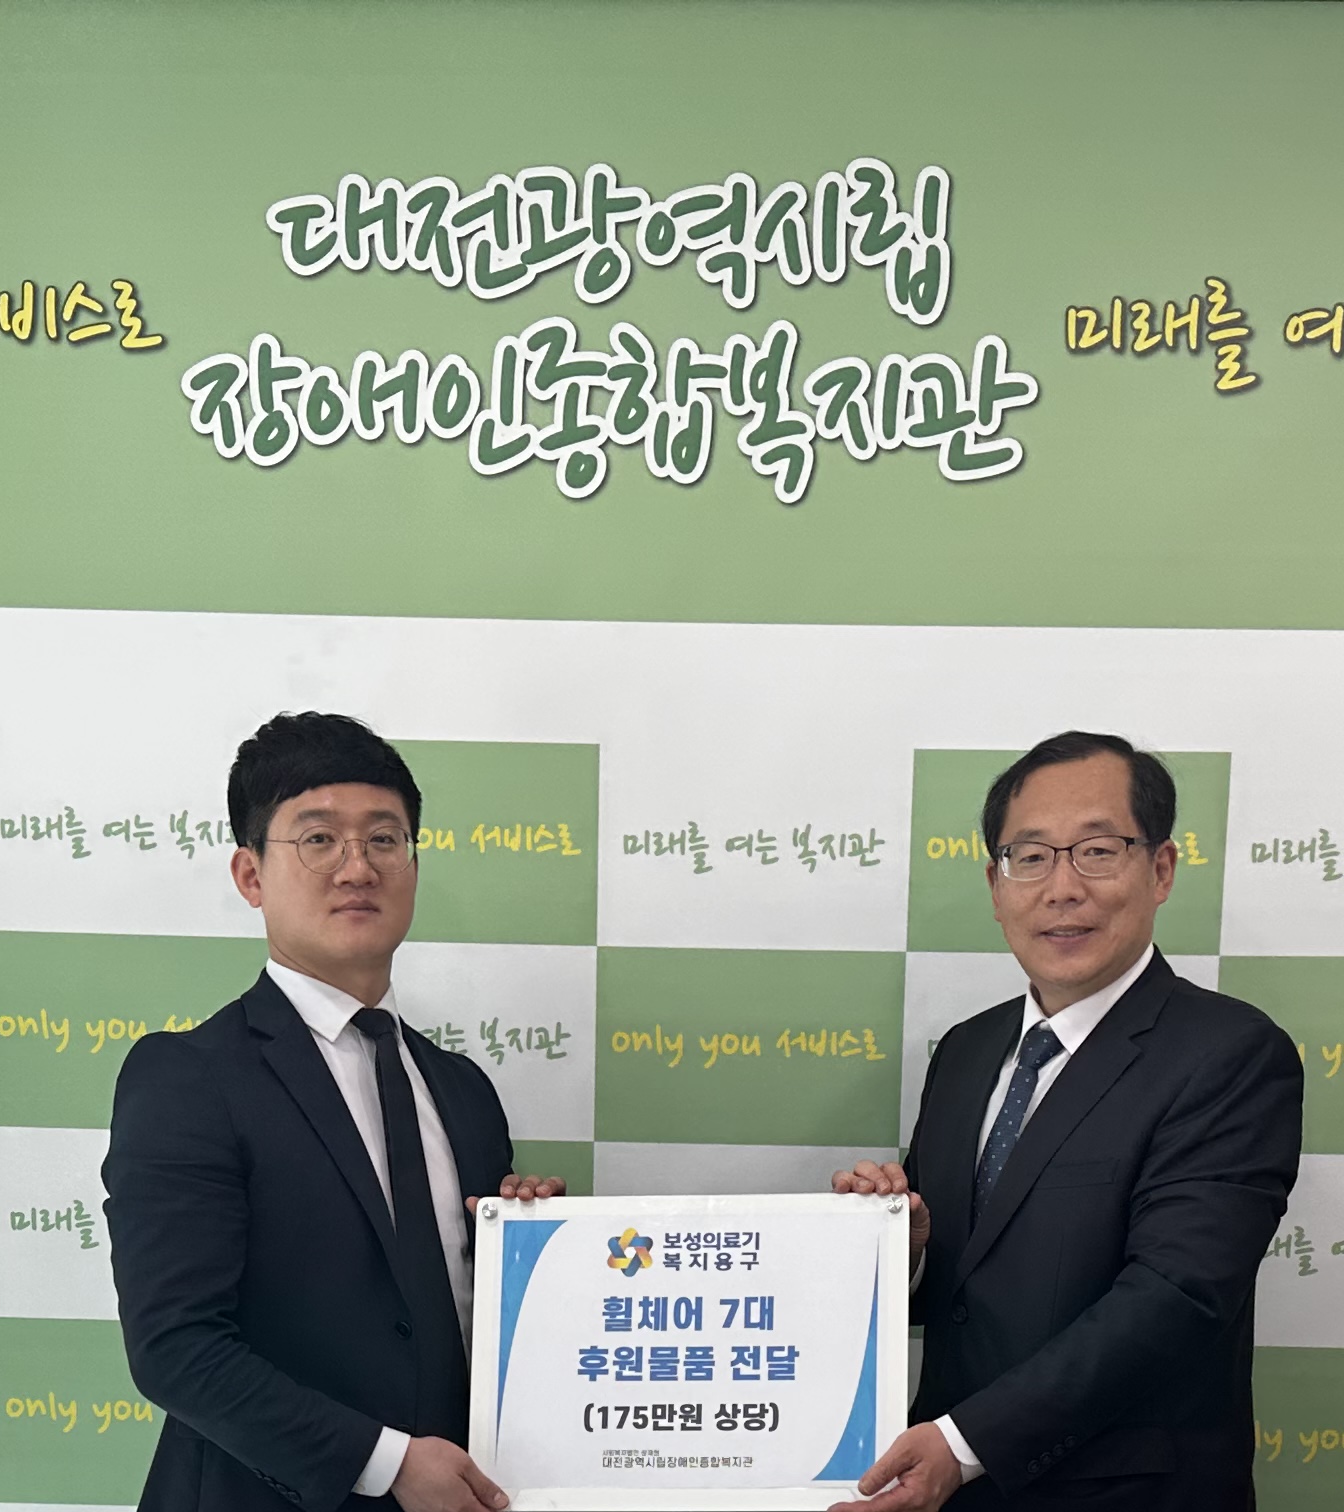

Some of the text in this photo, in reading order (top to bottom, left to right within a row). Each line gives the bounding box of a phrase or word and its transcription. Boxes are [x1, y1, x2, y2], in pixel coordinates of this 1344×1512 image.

[267, 157, 952, 326] 대전광역시립
[1068, 280, 1253, 389] 미래를
[180, 317, 1039, 505] 장애인종합복지관
[0, 806, 236, 859] 미래를 여는 복지
[417, 824, 580, 855] ou 서비스로
[623, 821, 885, 874] 미래를 여는 복지관
[926, 830, 989, 861] onl
[1251, 828, 1343, 882] 미래를
[85, 1018, 146, 1053] you
[479, 1016, 572, 1065] 복지관
[612, 1025, 884, 1068] only you 서비스로
[9, 1199, 100, 1250] 미래를
[663, 1231, 760, 1251] 보성의료기
[1264, 1226, 1319, 1277] 래를
[602, 1296, 775, 1333] 휠체어 7대
[577, 1345, 799, 1381] 후원물품 전달
[6, 1393, 152, 1432] only you
[583, 1403, 779, 1432] (175만원 상당)
[602, 1456, 753, 1468] 대전광역시립장애인종합복지관
